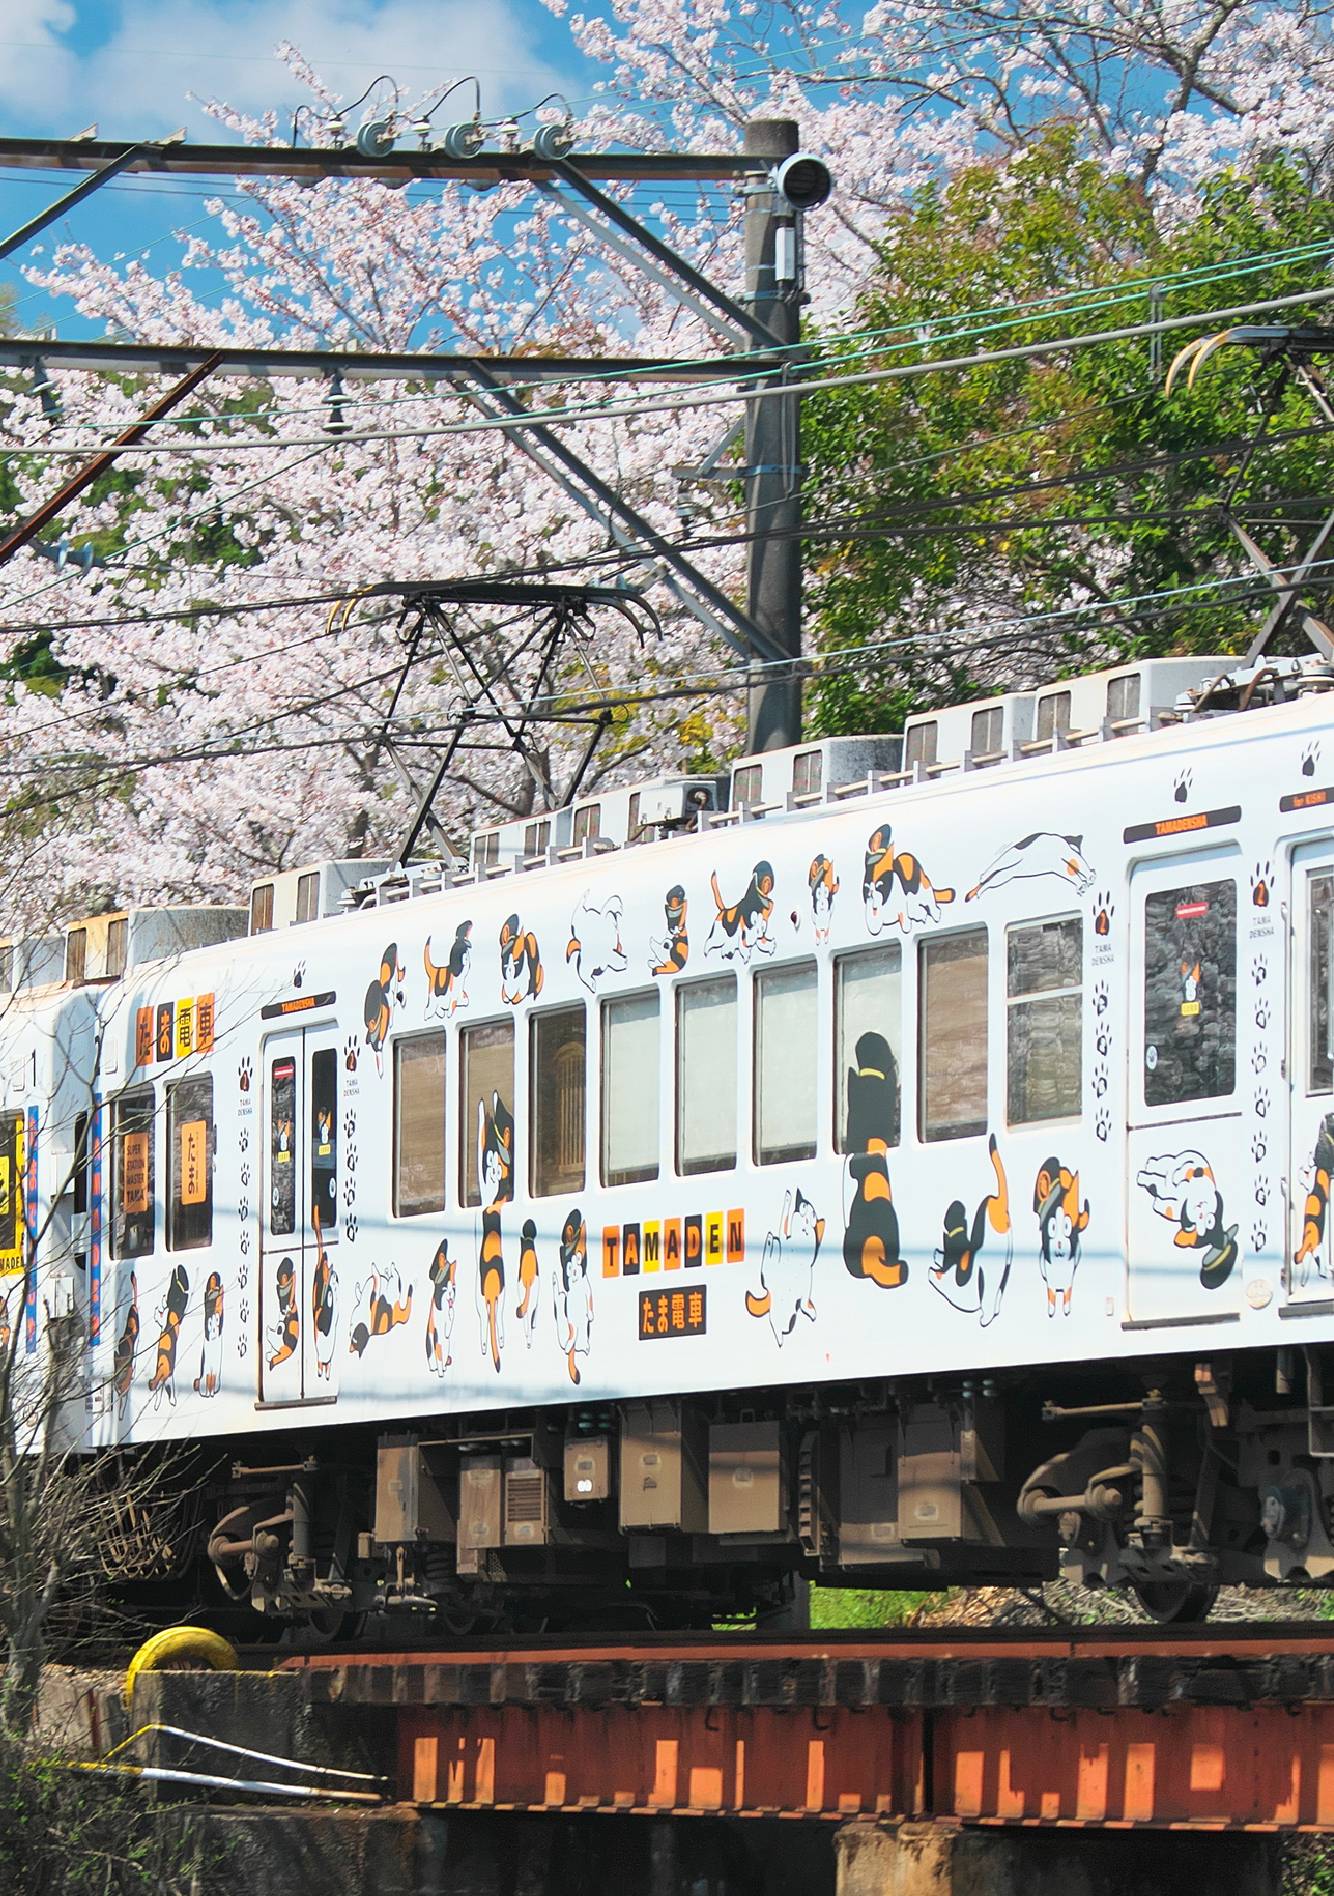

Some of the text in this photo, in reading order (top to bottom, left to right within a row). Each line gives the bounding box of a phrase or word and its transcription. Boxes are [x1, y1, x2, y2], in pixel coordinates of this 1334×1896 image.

[1155, 814, 1208, 836] TAMADENSHA
[127, 1144, 141, 1156] SUPER
[127, 1160, 144, 1170] STATION
[188, 1133, 195, 1194] たま
[127, 1173, 144, 1184] MASTER
[127, 1190, 144, 1202] TAMA
[606, 1221, 742, 1267] TAMADEN
[643, 1291, 703, 1334] たま電車
